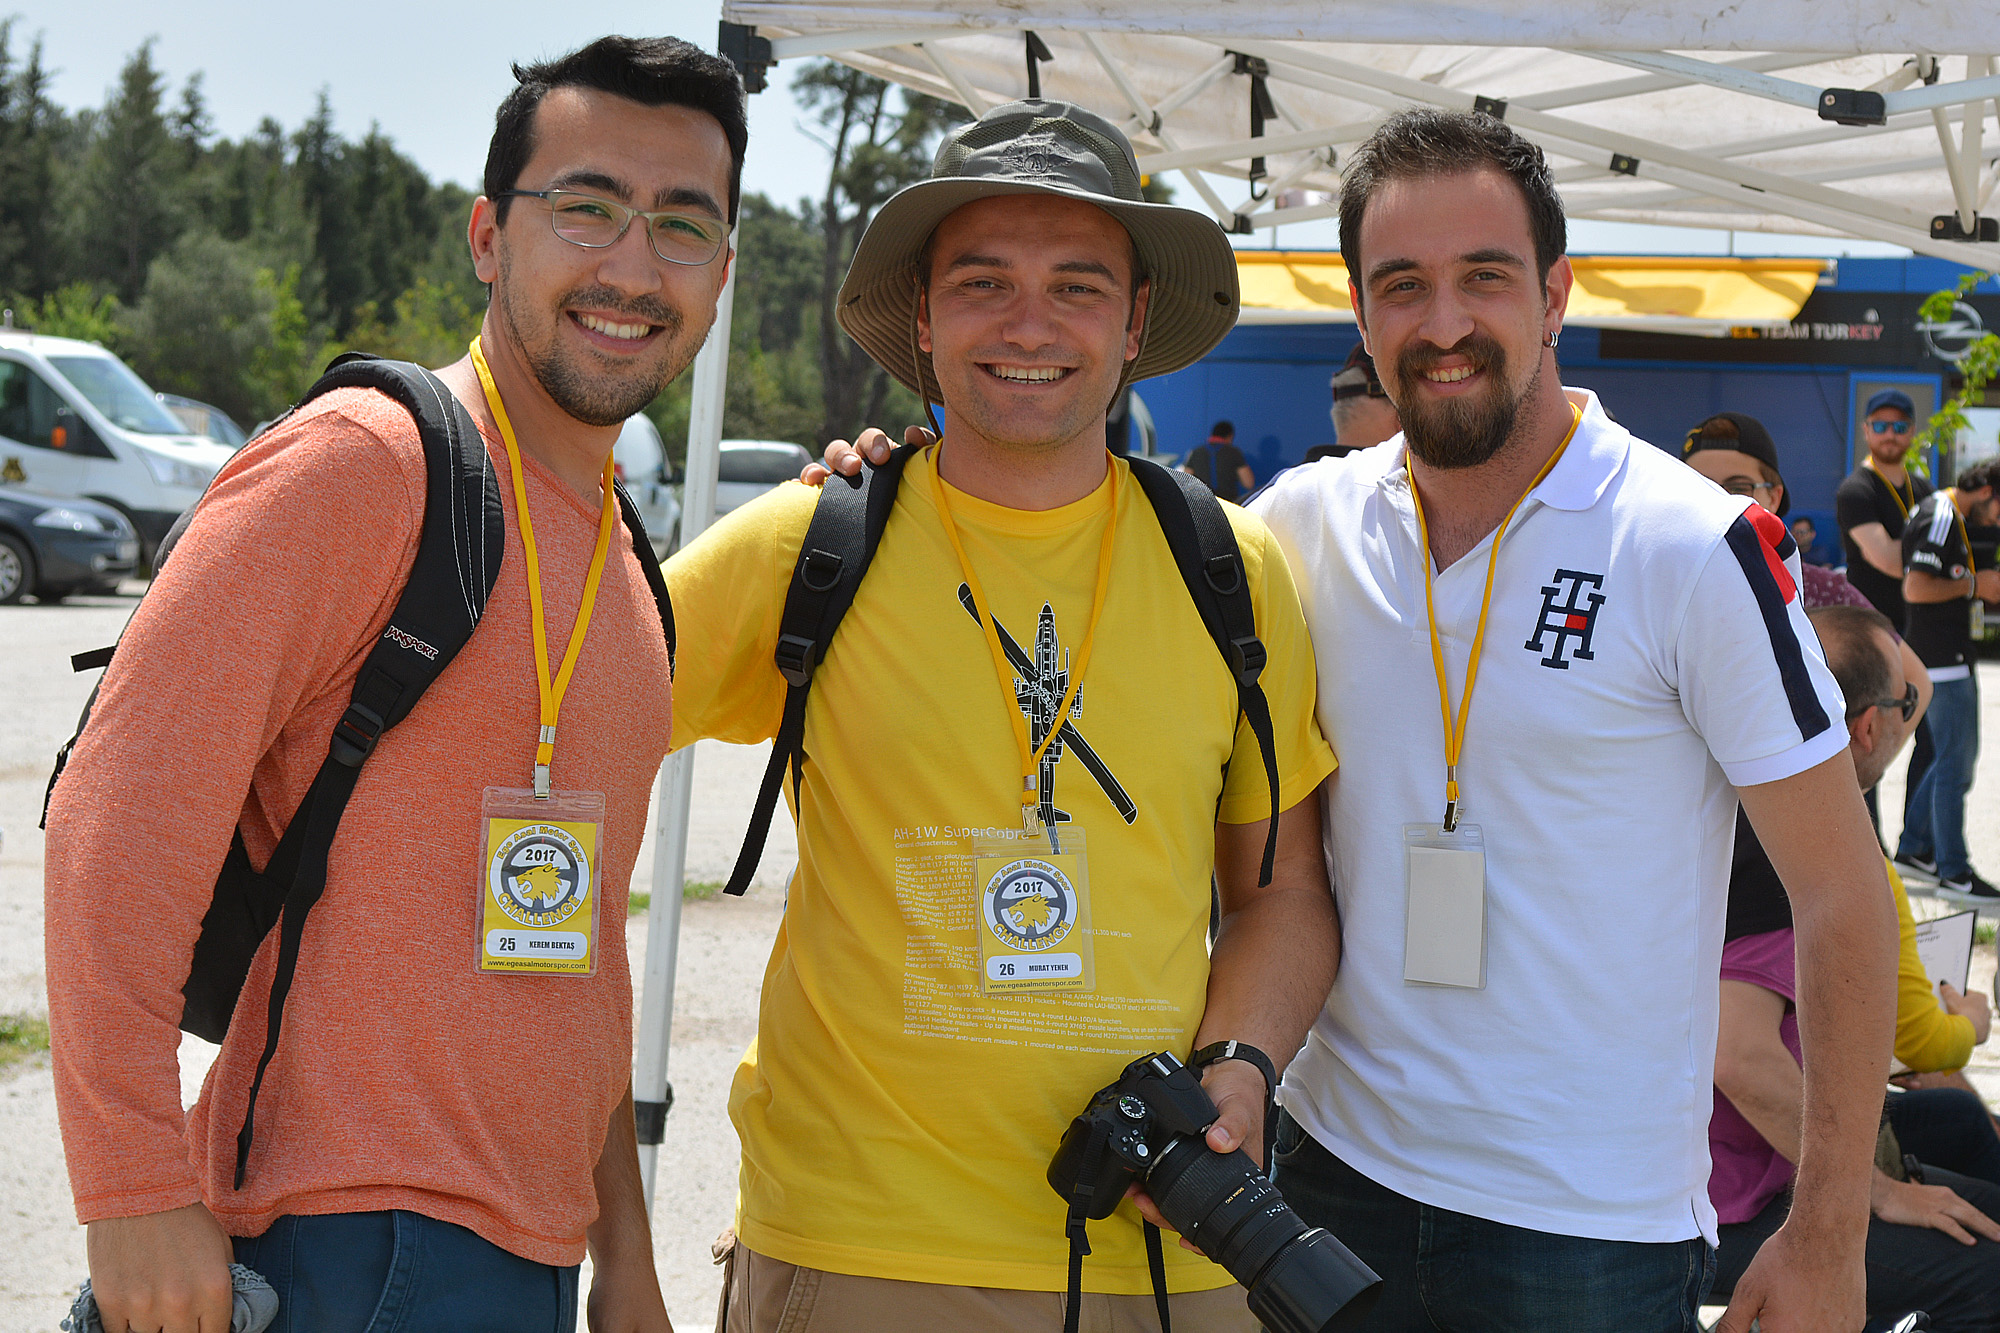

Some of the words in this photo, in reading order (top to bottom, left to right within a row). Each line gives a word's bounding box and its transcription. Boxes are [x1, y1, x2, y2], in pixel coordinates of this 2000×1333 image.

[1761, 323, 1810, 340] TEAM
[1811, 322, 1884, 340] TURKEY
[893, 826, 939, 840] AH-1W
[496, 840, 513, 860] Ege
[513, 826, 537, 842] Asal
[539, 825, 570, 841] Motor
[568, 839, 584, 863] Spor
[525, 849, 557, 862] 2017
[987, 876, 1002, 894] Ege
[1001, 861, 1022, 878] Asal
[1023, 860, 1053, 873] Motor
[1053, 871, 1071, 892] Spor
[1014, 881, 1043, 893] 2017
[497, 892, 581, 926] CHALLENGE
[993, 919, 1071, 950] CHALLENGE
[499, 937, 516, 951] 25
[529, 940, 550, 949] KEREM
[487, 959, 586, 970] www.egeasalmotorspor.com
[999, 963, 1015, 976] 26
[1028, 964, 1049, 972] MURAT
[904, 972, 937, 983] Armament
[989, 979, 1083, 990] www.egeasalmotorspor.com
